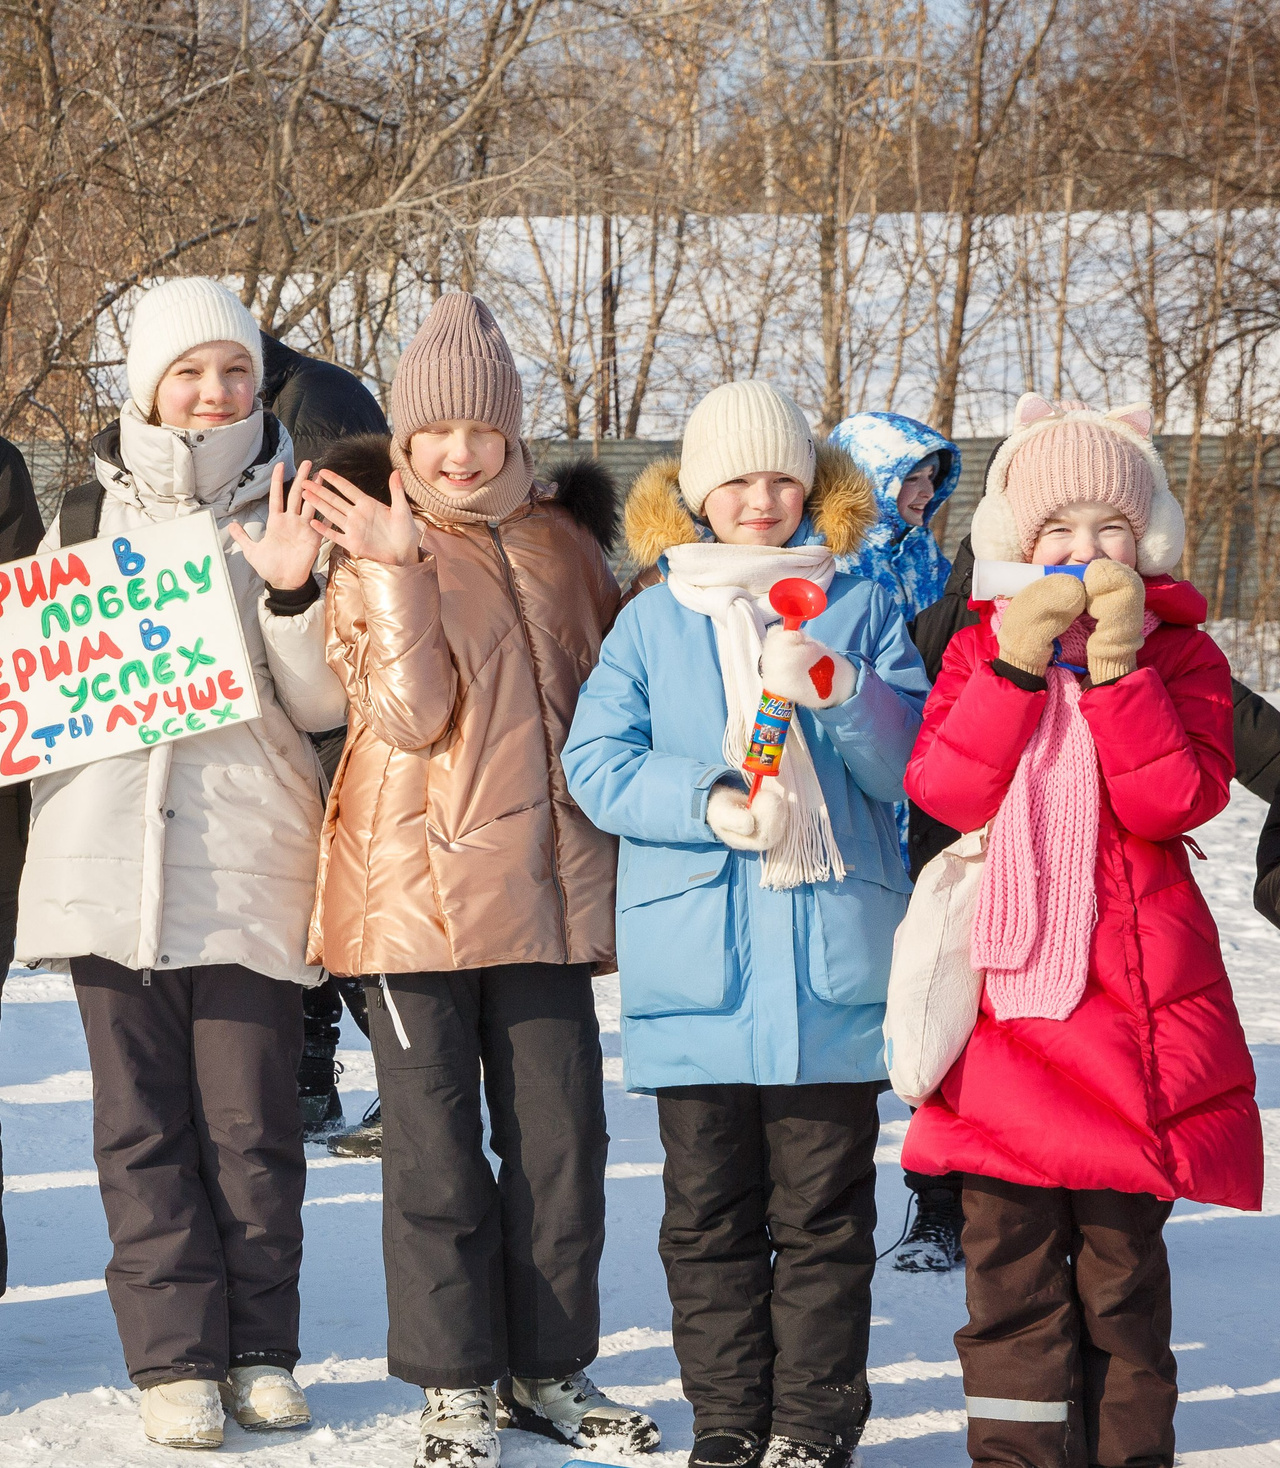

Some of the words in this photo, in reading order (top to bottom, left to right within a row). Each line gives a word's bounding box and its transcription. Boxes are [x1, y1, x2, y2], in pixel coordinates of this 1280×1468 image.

[112, 537, 146, 576] В
[41, 555, 212, 638] ПОБЕДУ
[139, 618, 170, 651] В
[59, 637, 217, 713] УСПЕХ
[31, 714, 94, 748] ТЫ
[106, 669, 244, 732] ЛУЧШЕ
[138, 702, 241, 745] ВСЕХ
